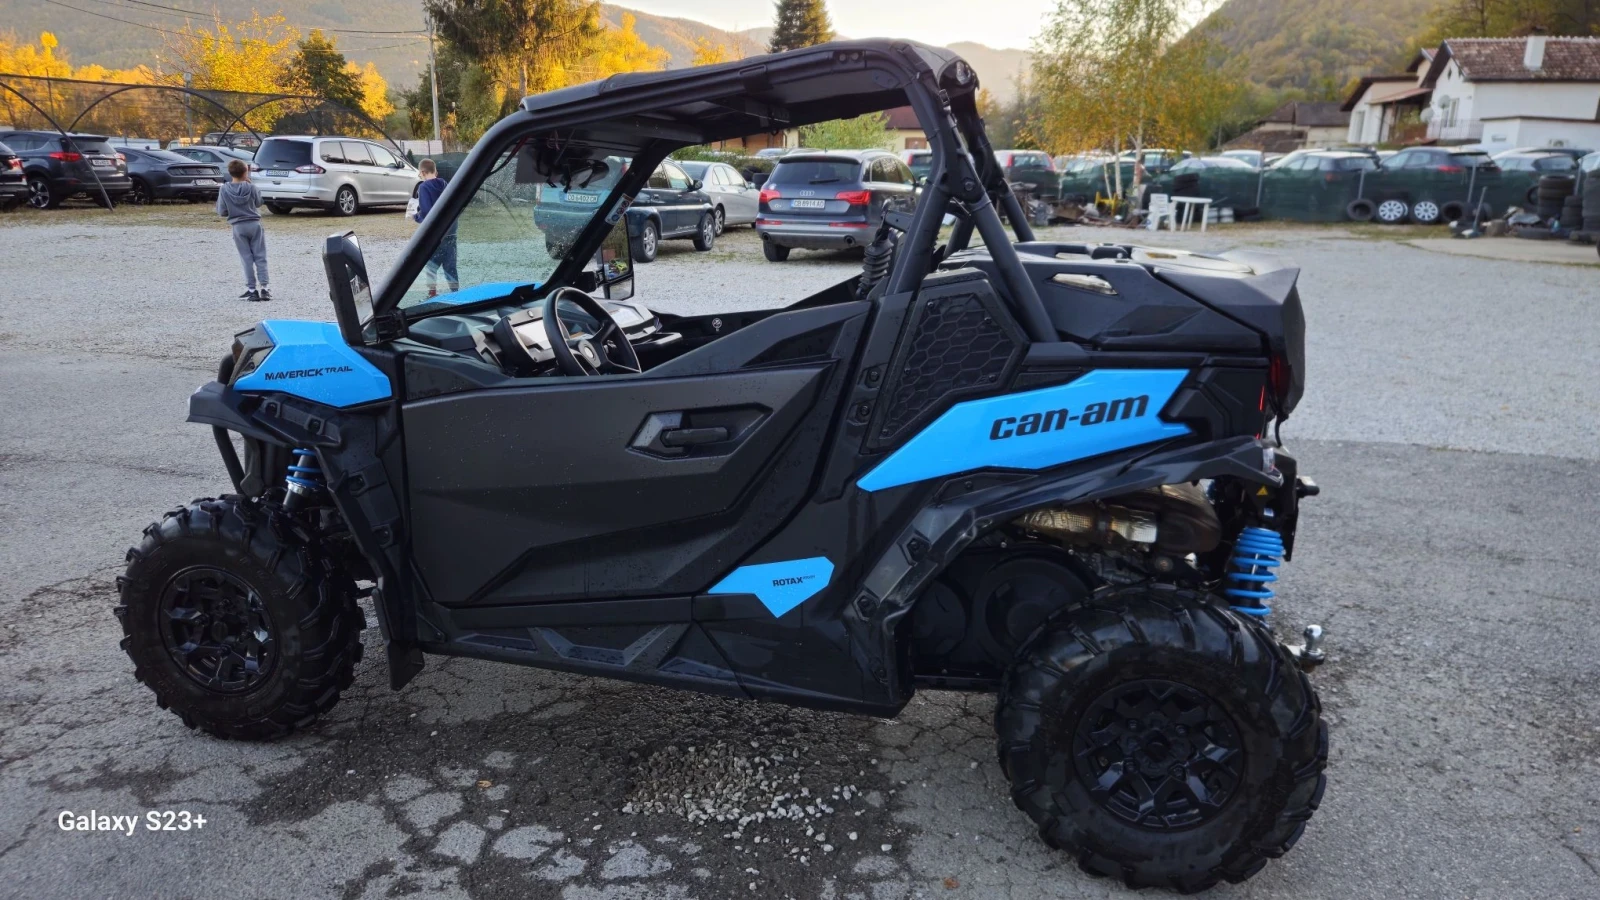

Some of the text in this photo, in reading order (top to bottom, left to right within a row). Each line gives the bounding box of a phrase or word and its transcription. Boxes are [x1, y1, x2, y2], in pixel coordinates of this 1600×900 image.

[265, 369, 323, 380] MAVERICK
[989, 394, 1150, 441] can-am
[772, 577, 803, 586] ROTAX
